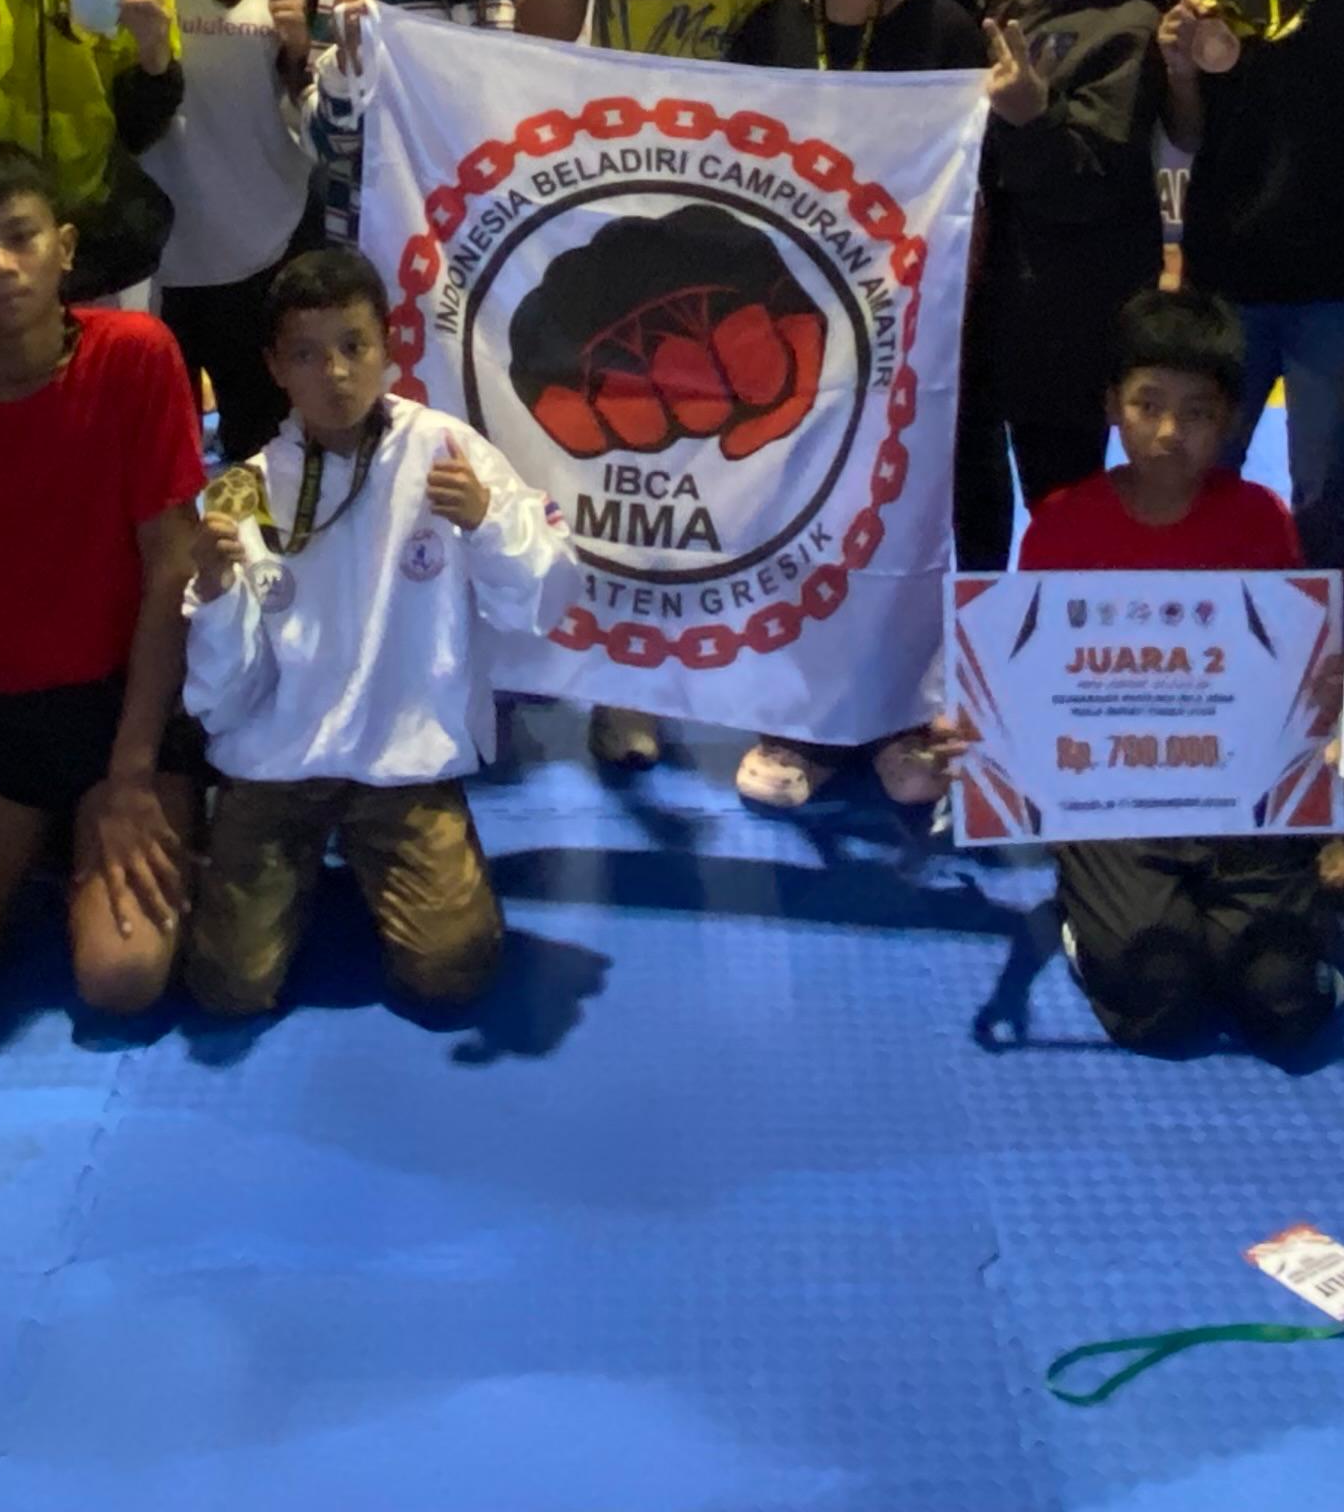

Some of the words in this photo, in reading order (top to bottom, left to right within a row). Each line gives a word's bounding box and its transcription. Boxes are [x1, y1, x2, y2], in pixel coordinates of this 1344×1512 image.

[434, 188, 532, 335] INDONESIA
[531, 147, 688, 198] BELADIRI
[698, 154, 873, 275] CAMPURAN
[856, 276, 898, 388] AMATIR
[603, 462, 700, 501] IBCA
[575, 493, 723, 552] MMA
[698, 521, 834, 616] GRESIK
[1065, 646, 1192, 674] JUARA
[1203, 646, 1225, 674] 2
